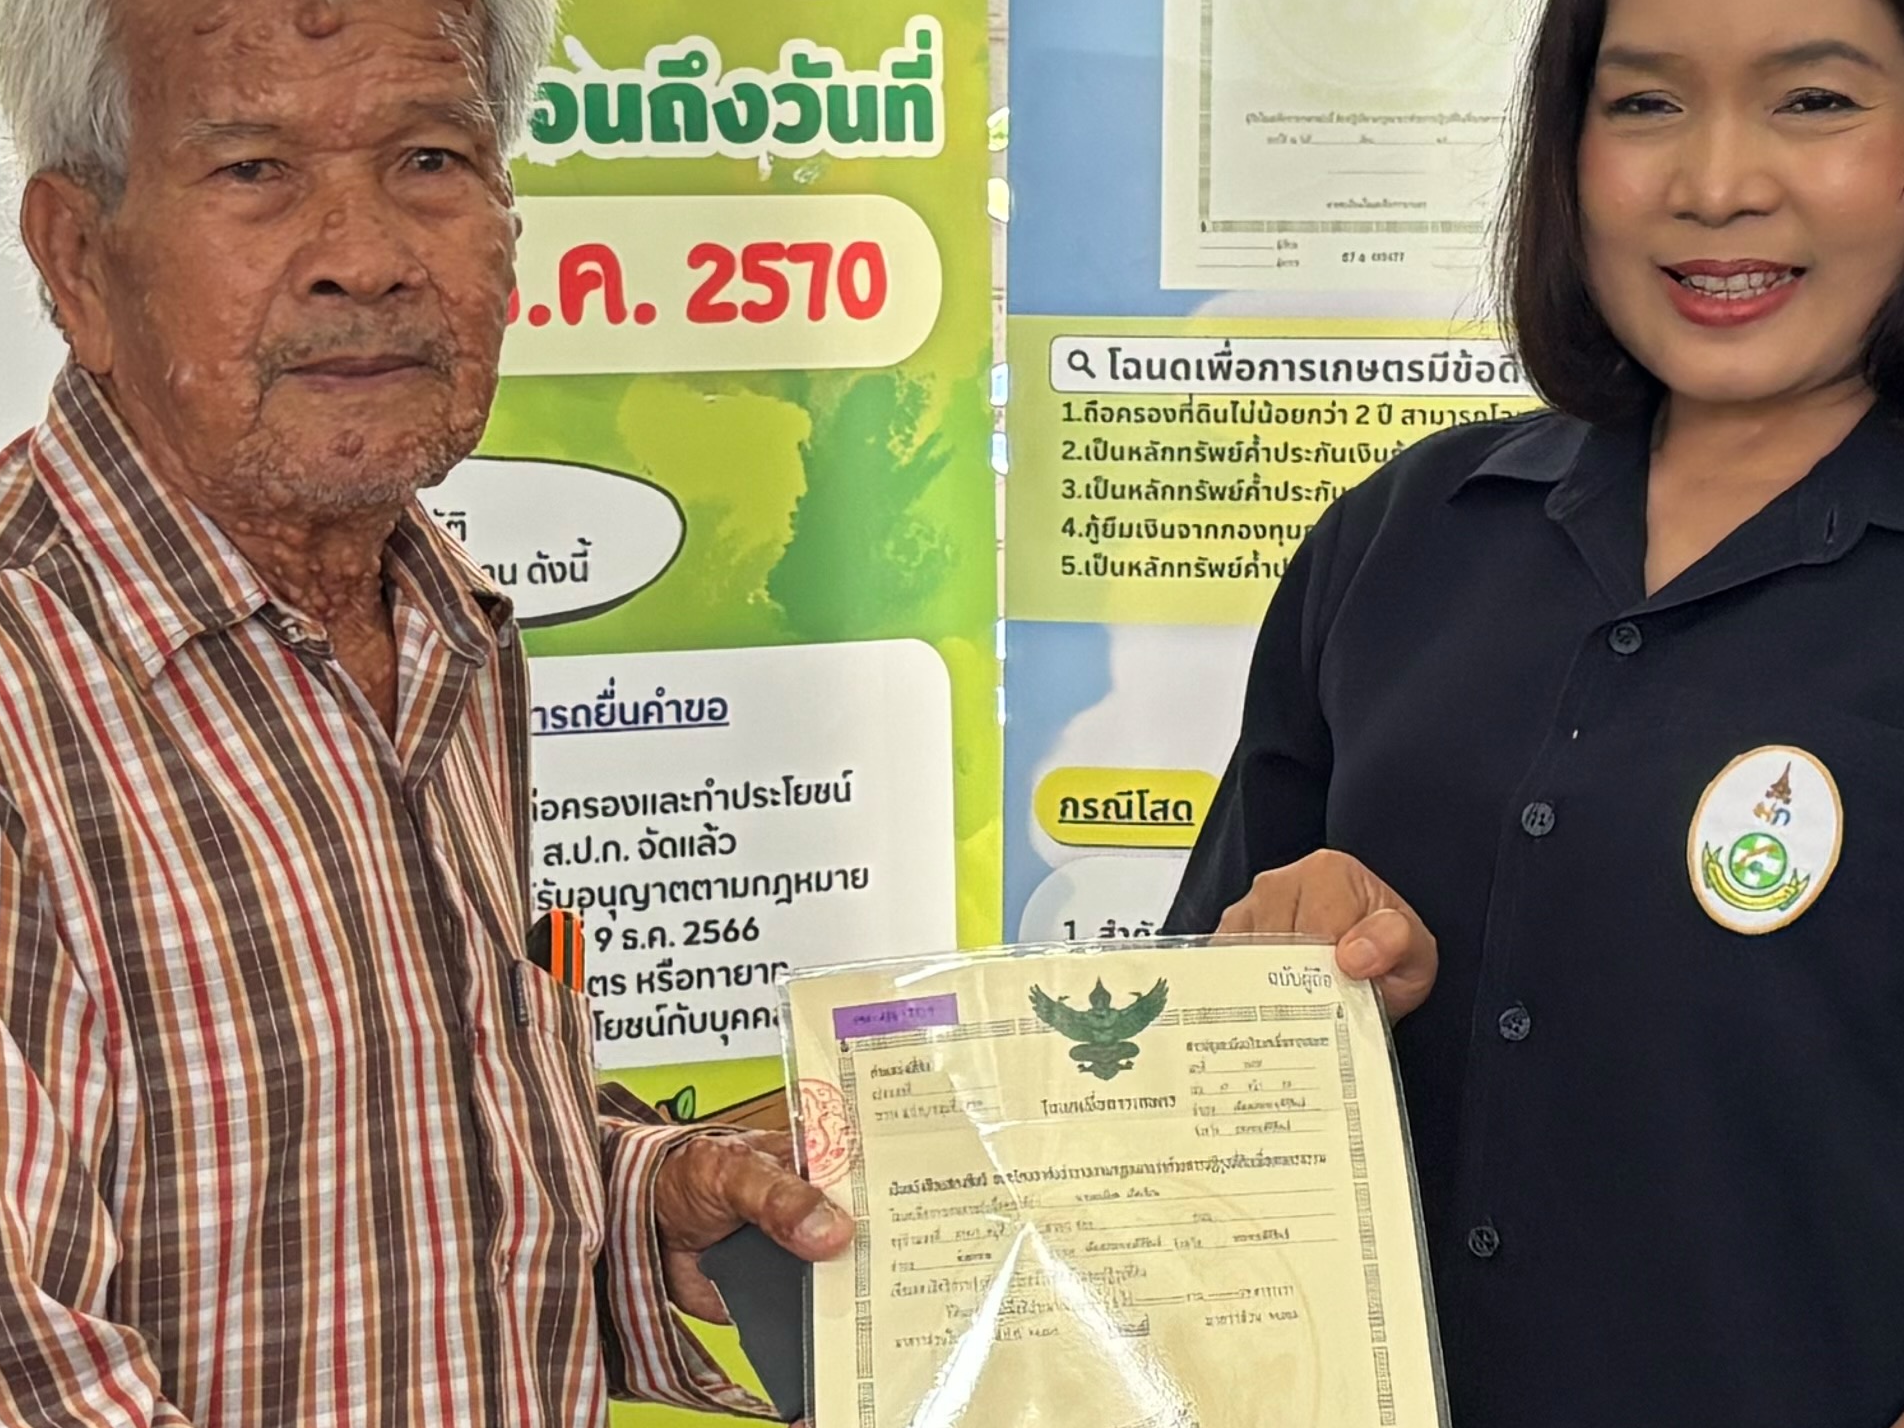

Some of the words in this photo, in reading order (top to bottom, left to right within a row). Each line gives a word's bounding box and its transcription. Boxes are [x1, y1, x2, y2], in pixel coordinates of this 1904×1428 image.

[507, 243, 657, 327] .ค.
[686, 241, 888, 323] 2570
[1061, 393, 1348, 425] 1.ถือครองที่ดินไม่น้อยกว่า
[1355, 404, 1370, 425] 2
[1377, 403, 1393, 425] ปี
[527, 537, 593, 584] ดังนี้
[532, 676, 729, 733] ารถยื่นคำขอ
[532, 769, 854, 822] อครองและทำประโยชน์
[1059, 789, 1194, 822] กรณีโสด
[542, 835, 630, 867] ส.ป.ก.
[636, 822, 737, 861] จัดแล้ว
[533, 866, 870, 921] รับอนุญาตตามกฎหมาย
[622, 924, 676, 950] ธ.ค.
[683, 916, 760, 947] 2566
[593, 1002, 782, 1046] โยชน์กับบุคค
